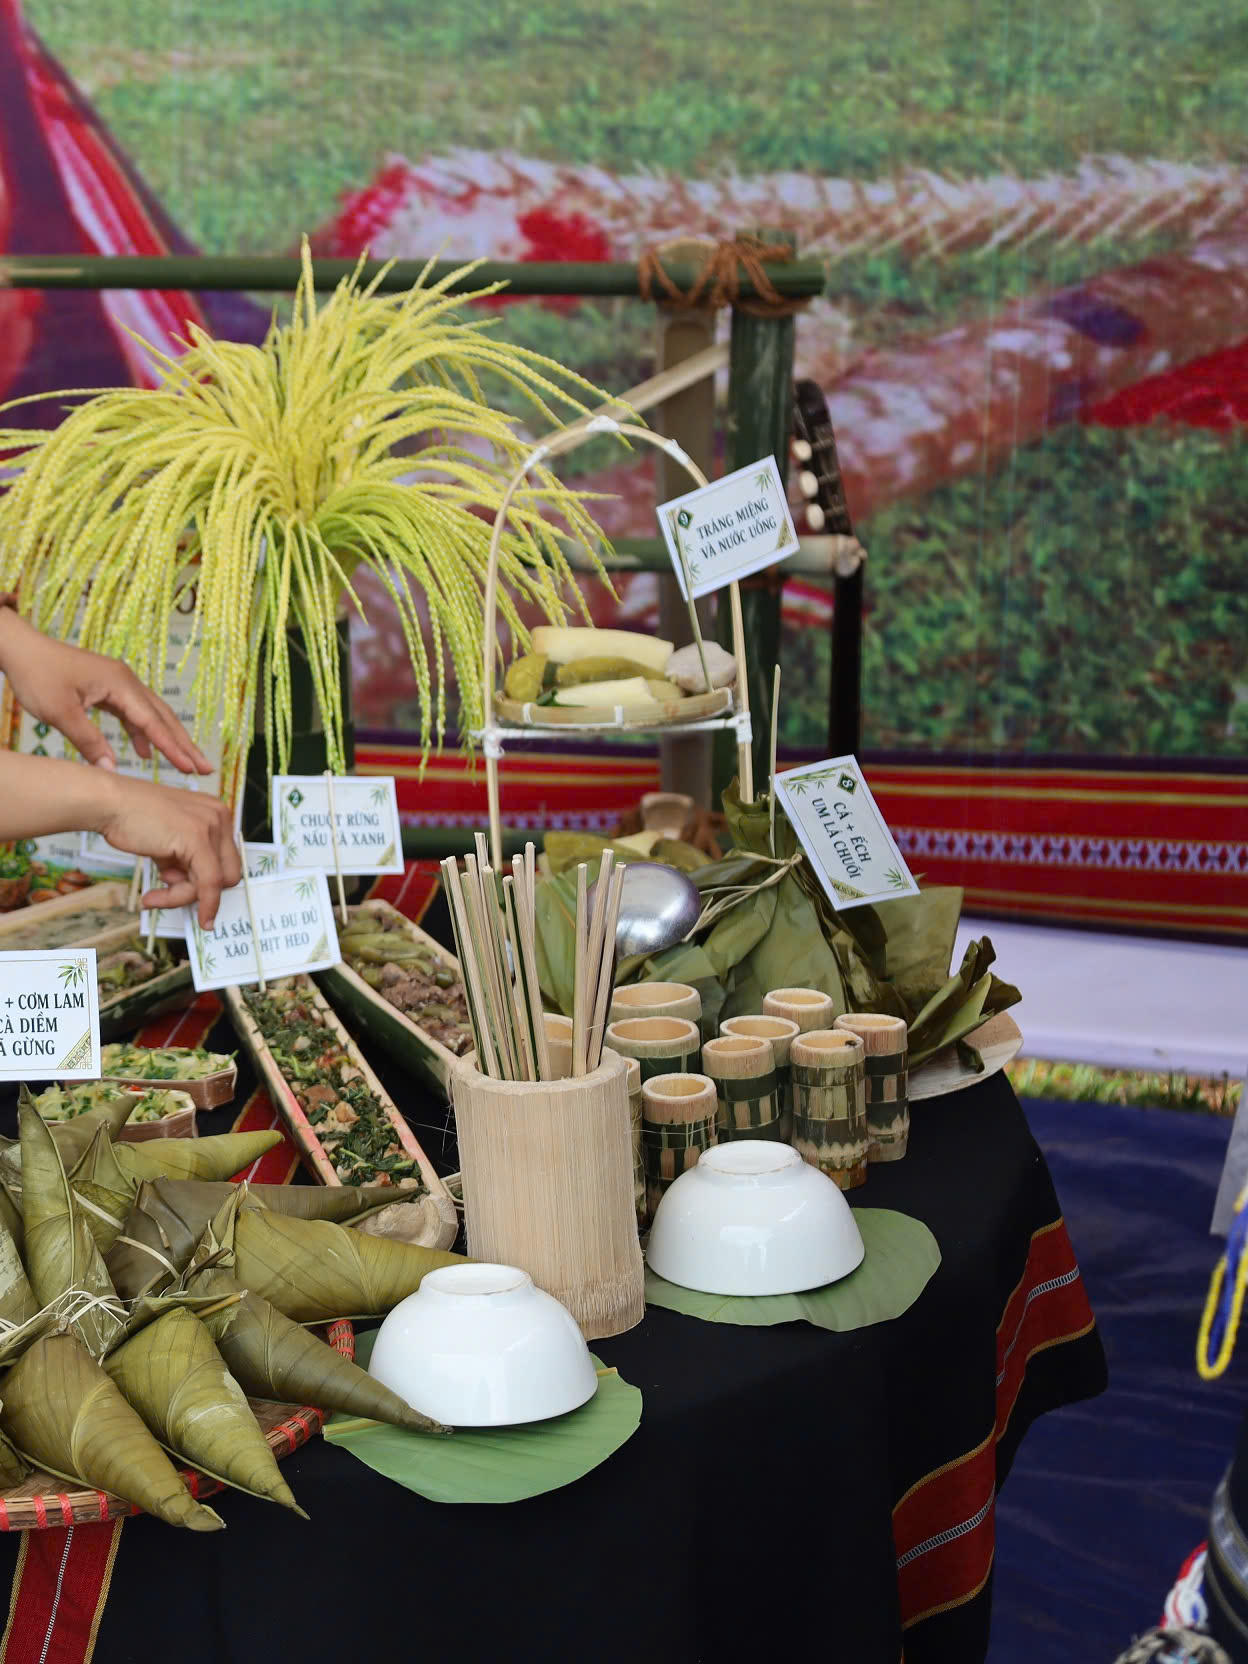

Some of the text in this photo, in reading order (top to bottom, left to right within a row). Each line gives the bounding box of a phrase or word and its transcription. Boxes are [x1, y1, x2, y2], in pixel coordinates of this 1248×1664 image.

[697, 514, 734, 540] TRÁNG
[700, 543, 717, 559] VÀ
[842, 779, 853, 788] 8
[351, 832, 386, 847] XANH
[812, 797, 862, 879] UM LÁ CHUỐI
[833, 801, 852, 820] CÁ
[850, 834, 872, 862] ẾCH
[280, 911, 299, 931] ĐU
[252, 935, 284, 955] HỊT
[285, 930, 310, 948] HEO
[4, 997, 14, 1009] +
[18, 992, 50, 1010] CƠM
[54, 992, 85, 1009] LAM
[20, 1010, 58, 1033] DIỀM
[12, 1036, 56, 1056] GỪNG
